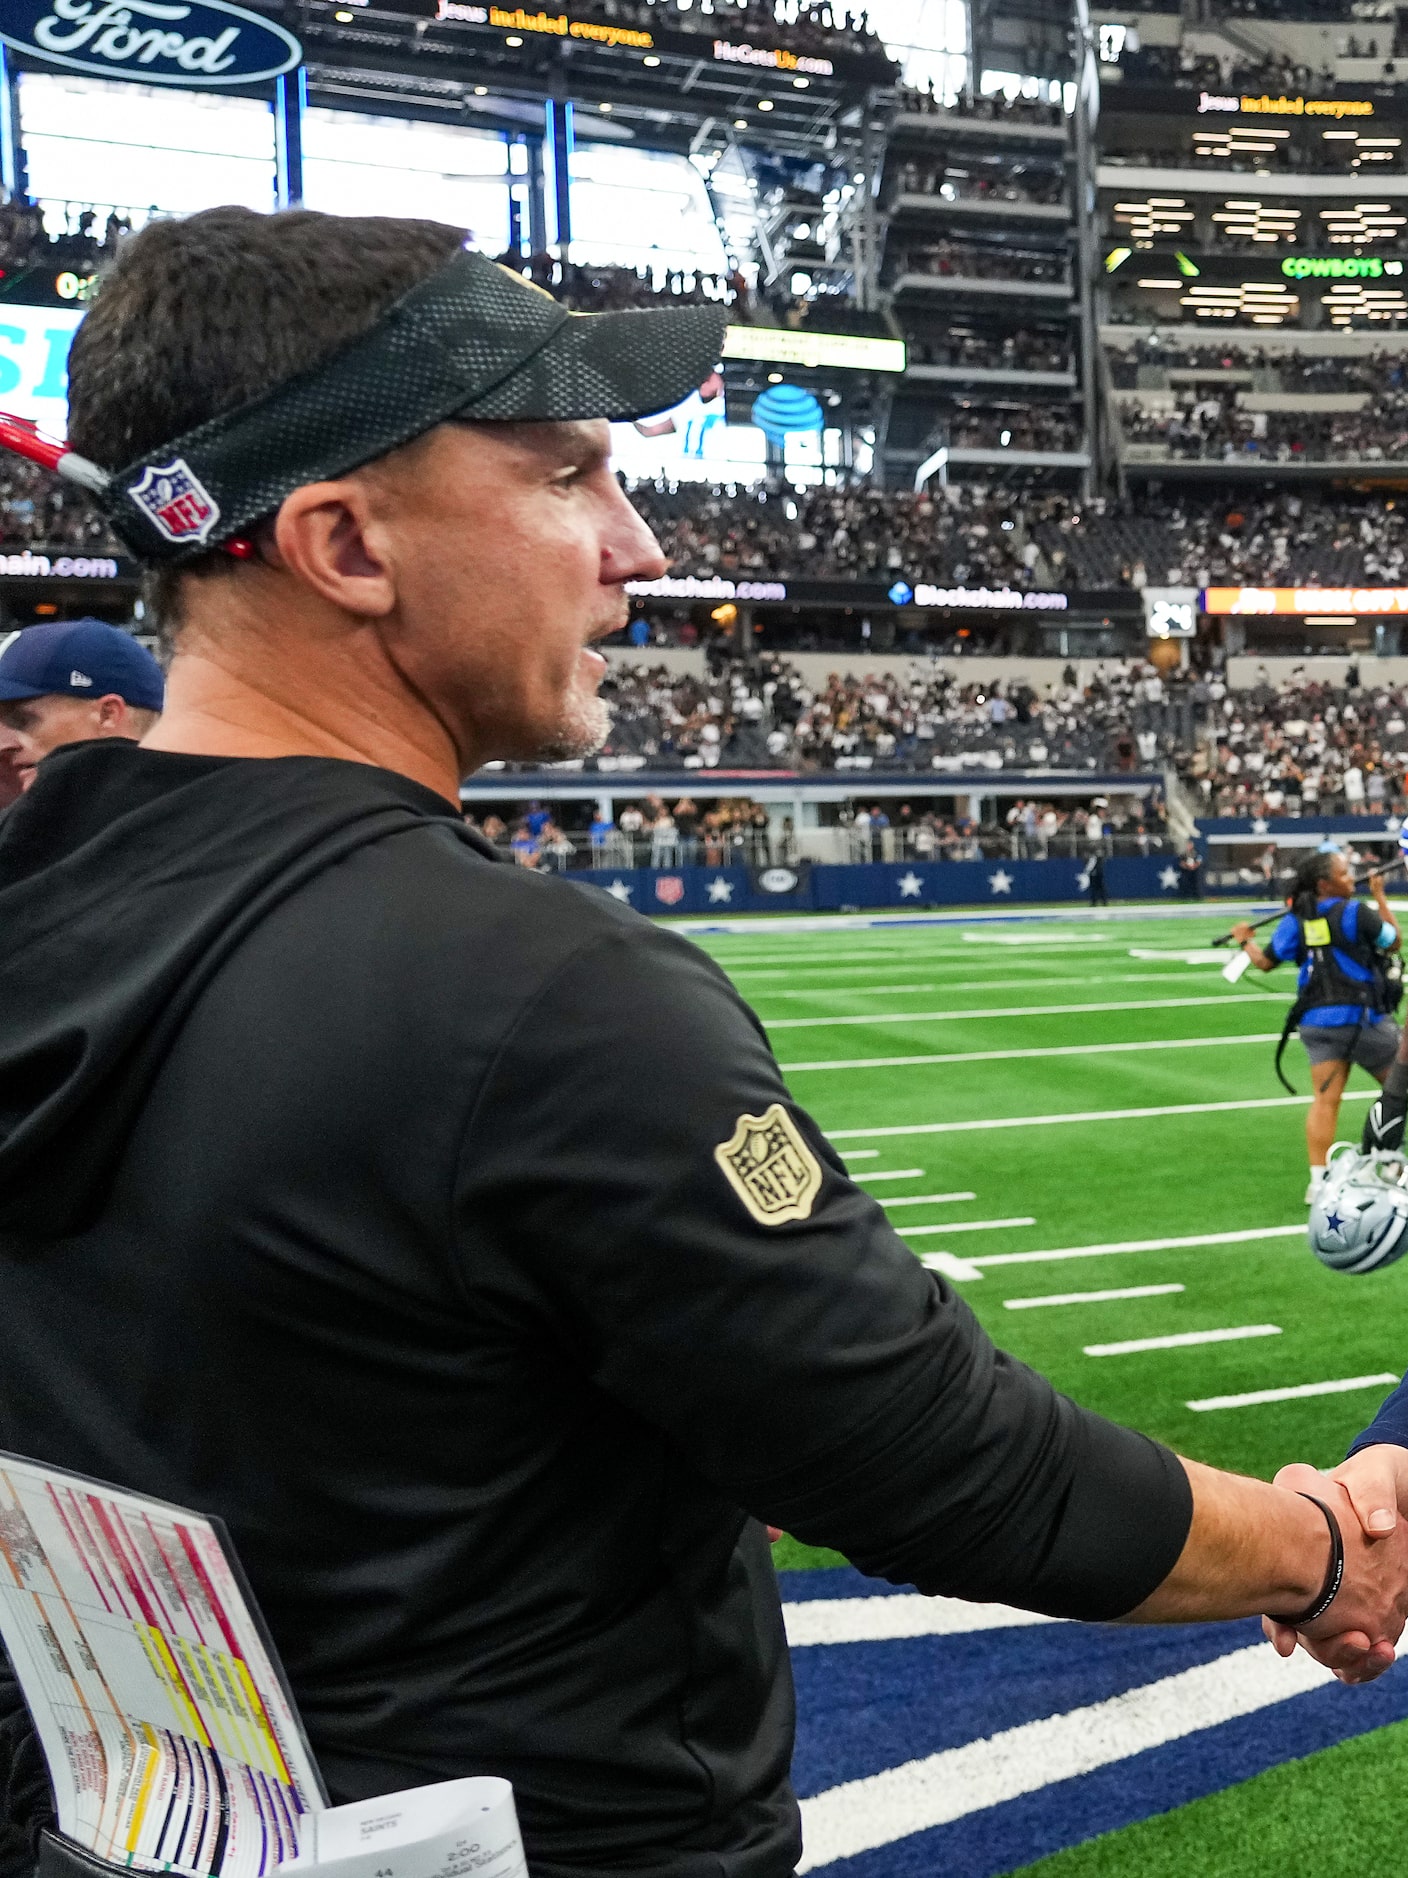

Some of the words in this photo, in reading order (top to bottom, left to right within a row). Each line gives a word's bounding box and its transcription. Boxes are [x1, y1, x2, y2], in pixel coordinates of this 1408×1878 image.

[34, 0, 241, 73] Ford
[490, 7, 568, 36] included
[1197, 91, 1240, 113] Jesus
[1240, 94, 1304, 115] included
[1281, 257, 1384, 279] COWBOYS
[156, 493, 210, 535] NFL
[751, 1153, 806, 1207] NFL
